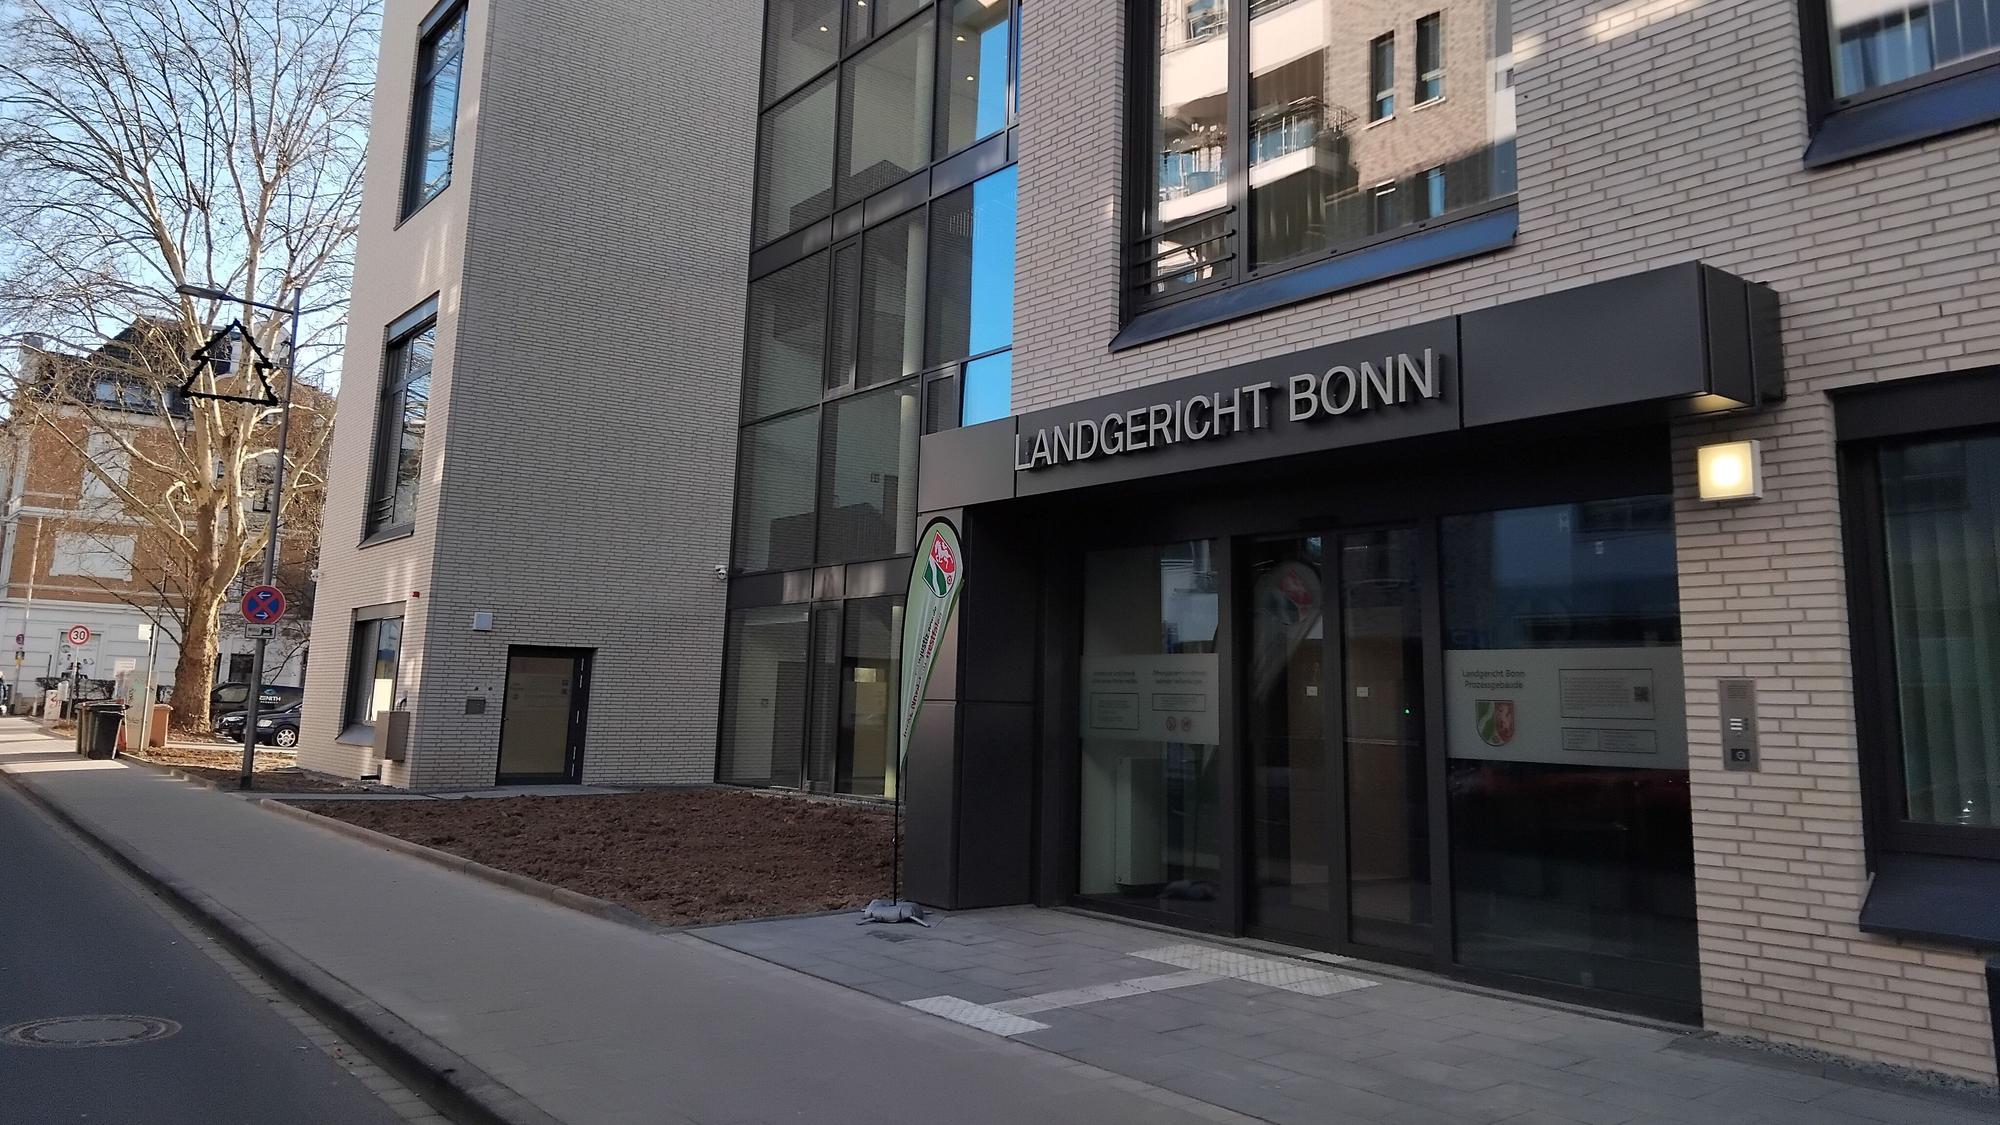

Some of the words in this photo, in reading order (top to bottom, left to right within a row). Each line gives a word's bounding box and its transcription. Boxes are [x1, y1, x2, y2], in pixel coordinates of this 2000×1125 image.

[1014, 380, 1273, 471] LANDGERICHT
[1288, 347, 1436, 424] BONN
[72, 630, 86, 641] 30
[1462, 669, 1504, 679] Landgericht
[1505, 670, 1526, 678] Bonn
